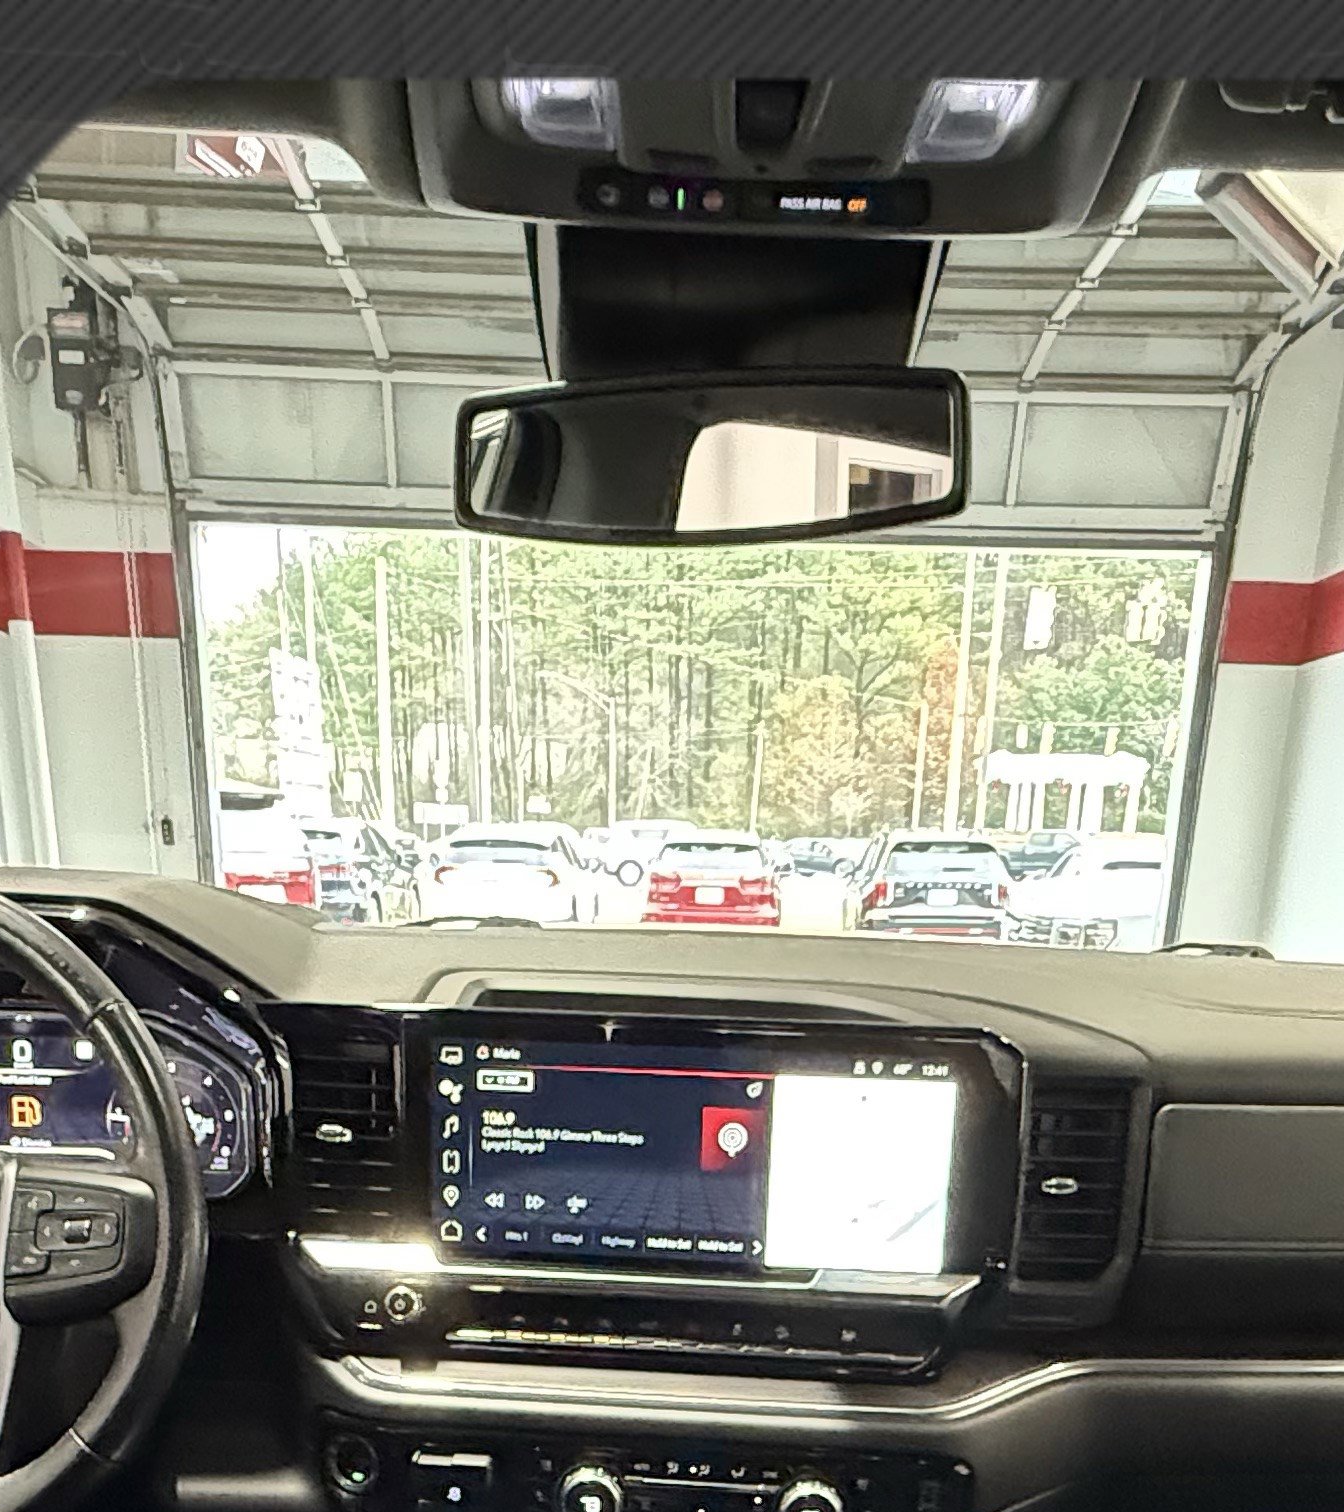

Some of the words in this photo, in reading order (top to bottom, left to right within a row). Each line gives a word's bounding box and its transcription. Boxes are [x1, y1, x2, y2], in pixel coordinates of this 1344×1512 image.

[780, 197, 805, 210] PASS
[805, 197, 821, 210] AIR
[821, 198, 842, 211] BAG
[847, 198, 867, 212] OFF
